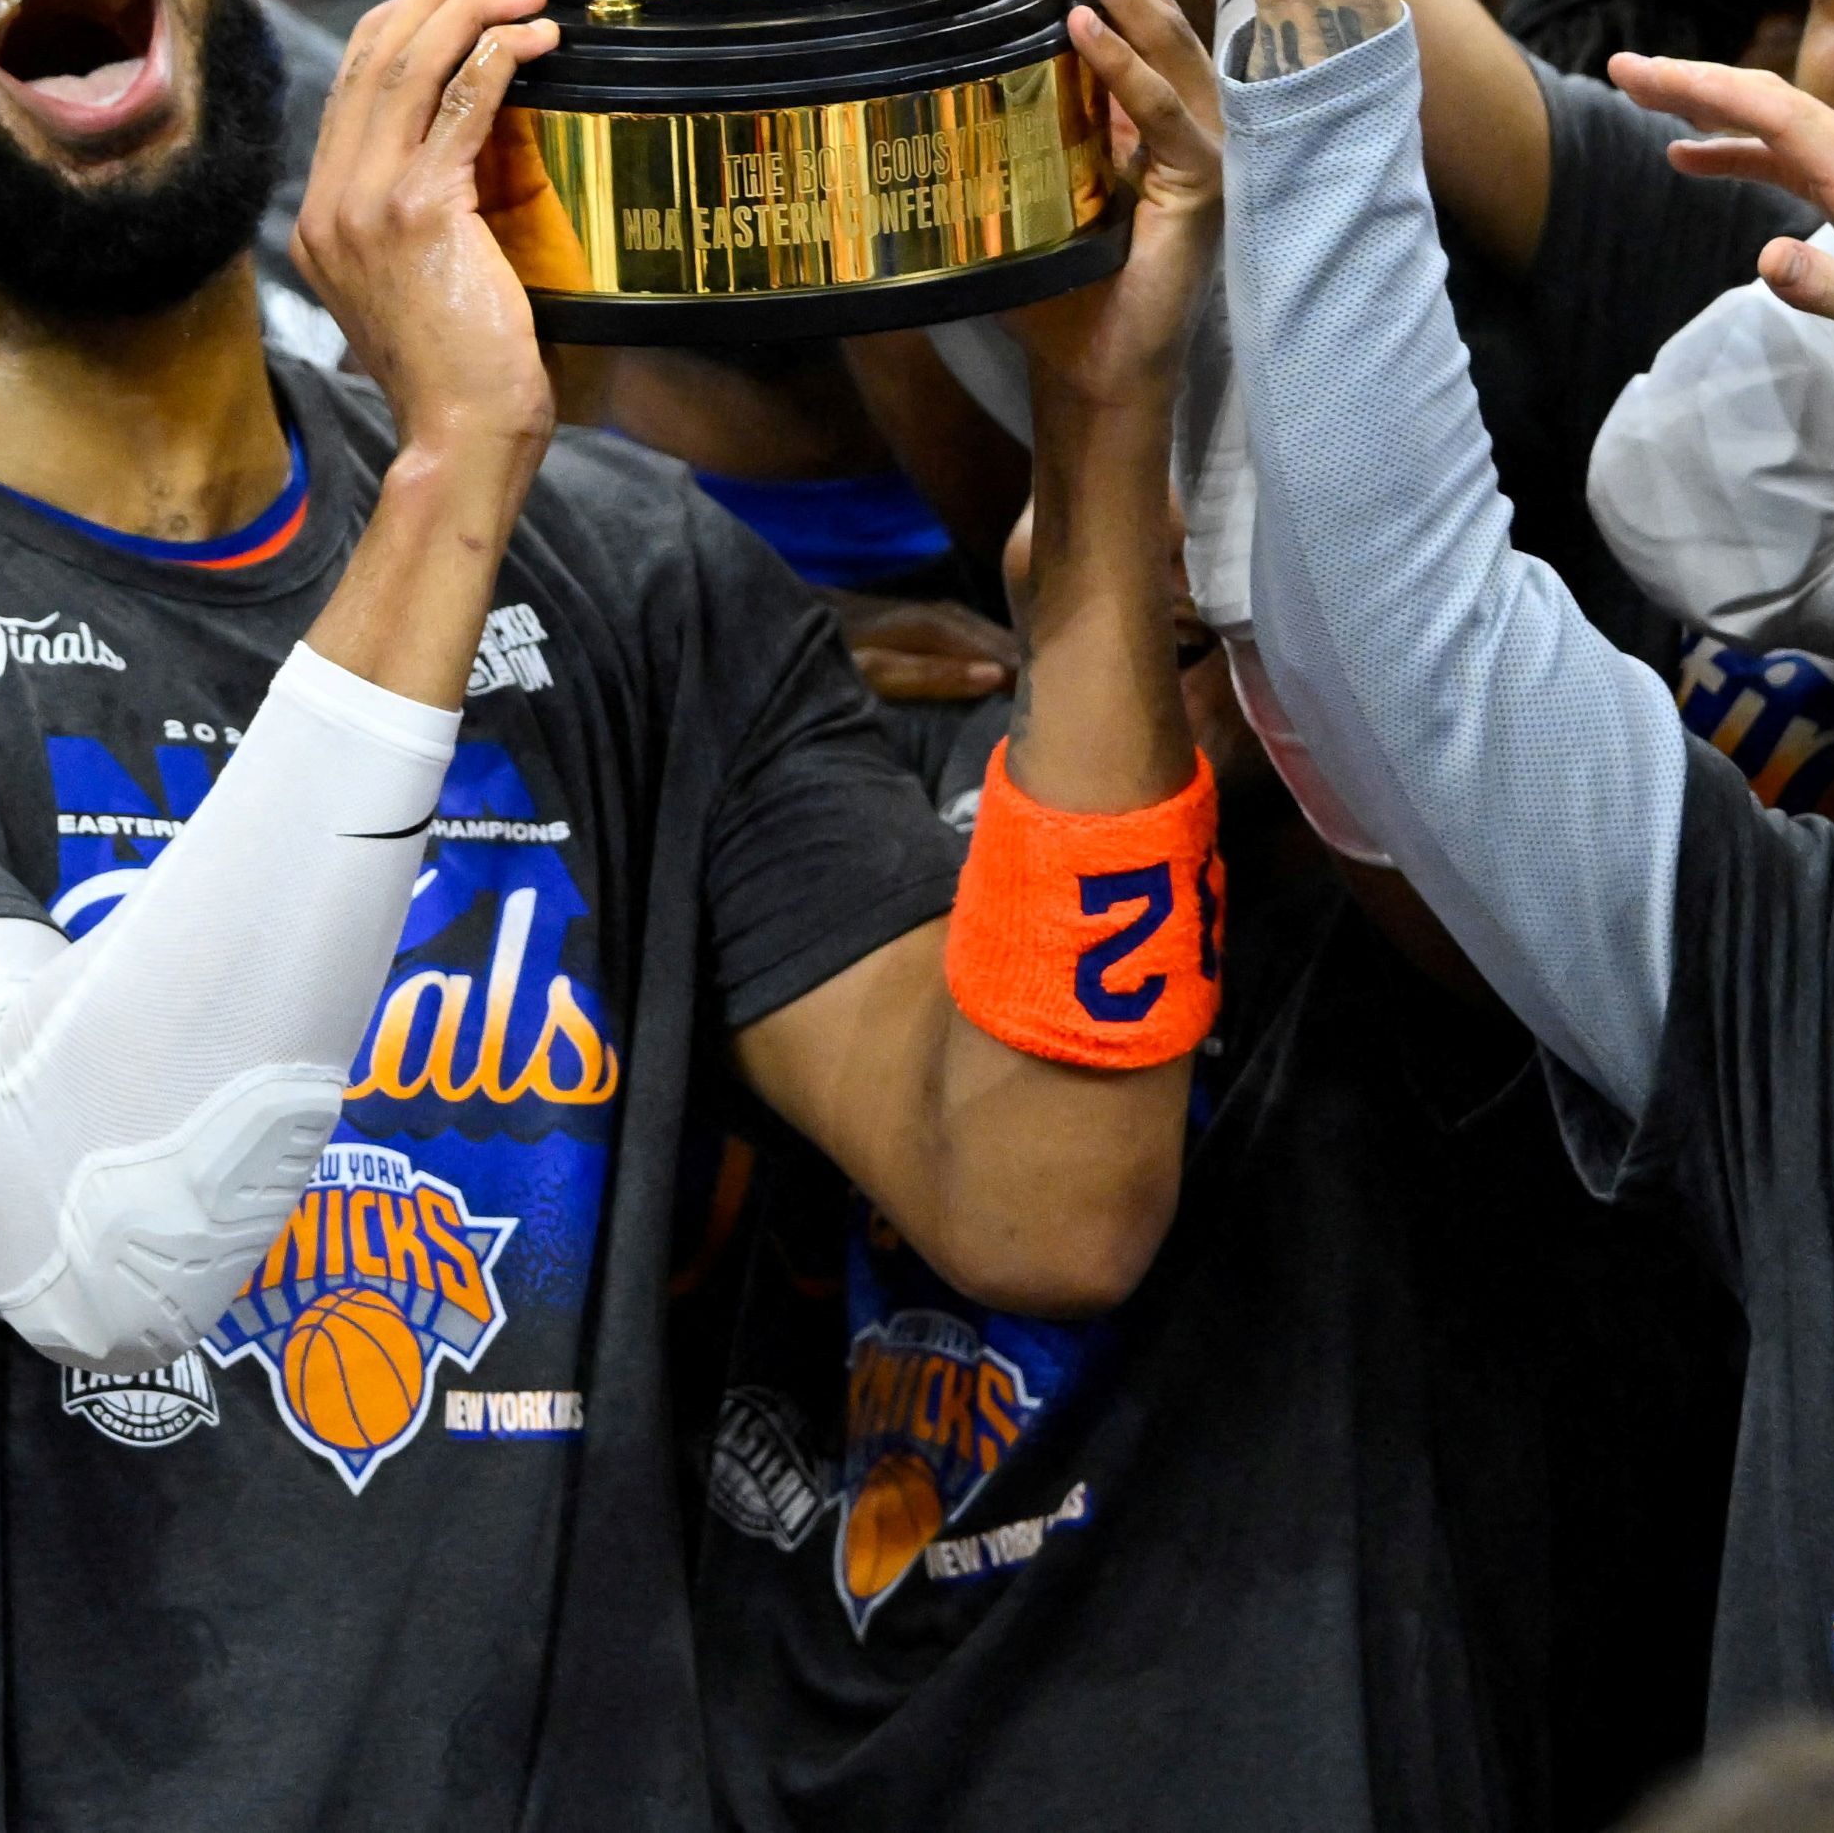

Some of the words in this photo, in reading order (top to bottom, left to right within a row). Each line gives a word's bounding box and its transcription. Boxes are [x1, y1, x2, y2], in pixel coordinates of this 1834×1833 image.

[723, 151, 786, 200] THE
[796, 143, 858, 194] BOB
[871, 125, 967, 186] COUSY
[622, 207, 681, 251] NBA
[690, 199, 834, 250] EASTERN
[841, 168, 1012, 240] CONFERENCE
[428, 818, 571, 843] HAMPIONS
[349, 1151, 410, 1189] YORK
[245, 1186, 494, 1324] NICKS
[444, 1390, 484, 1430] NEW
[486, 1390, 552, 1431] YORK
